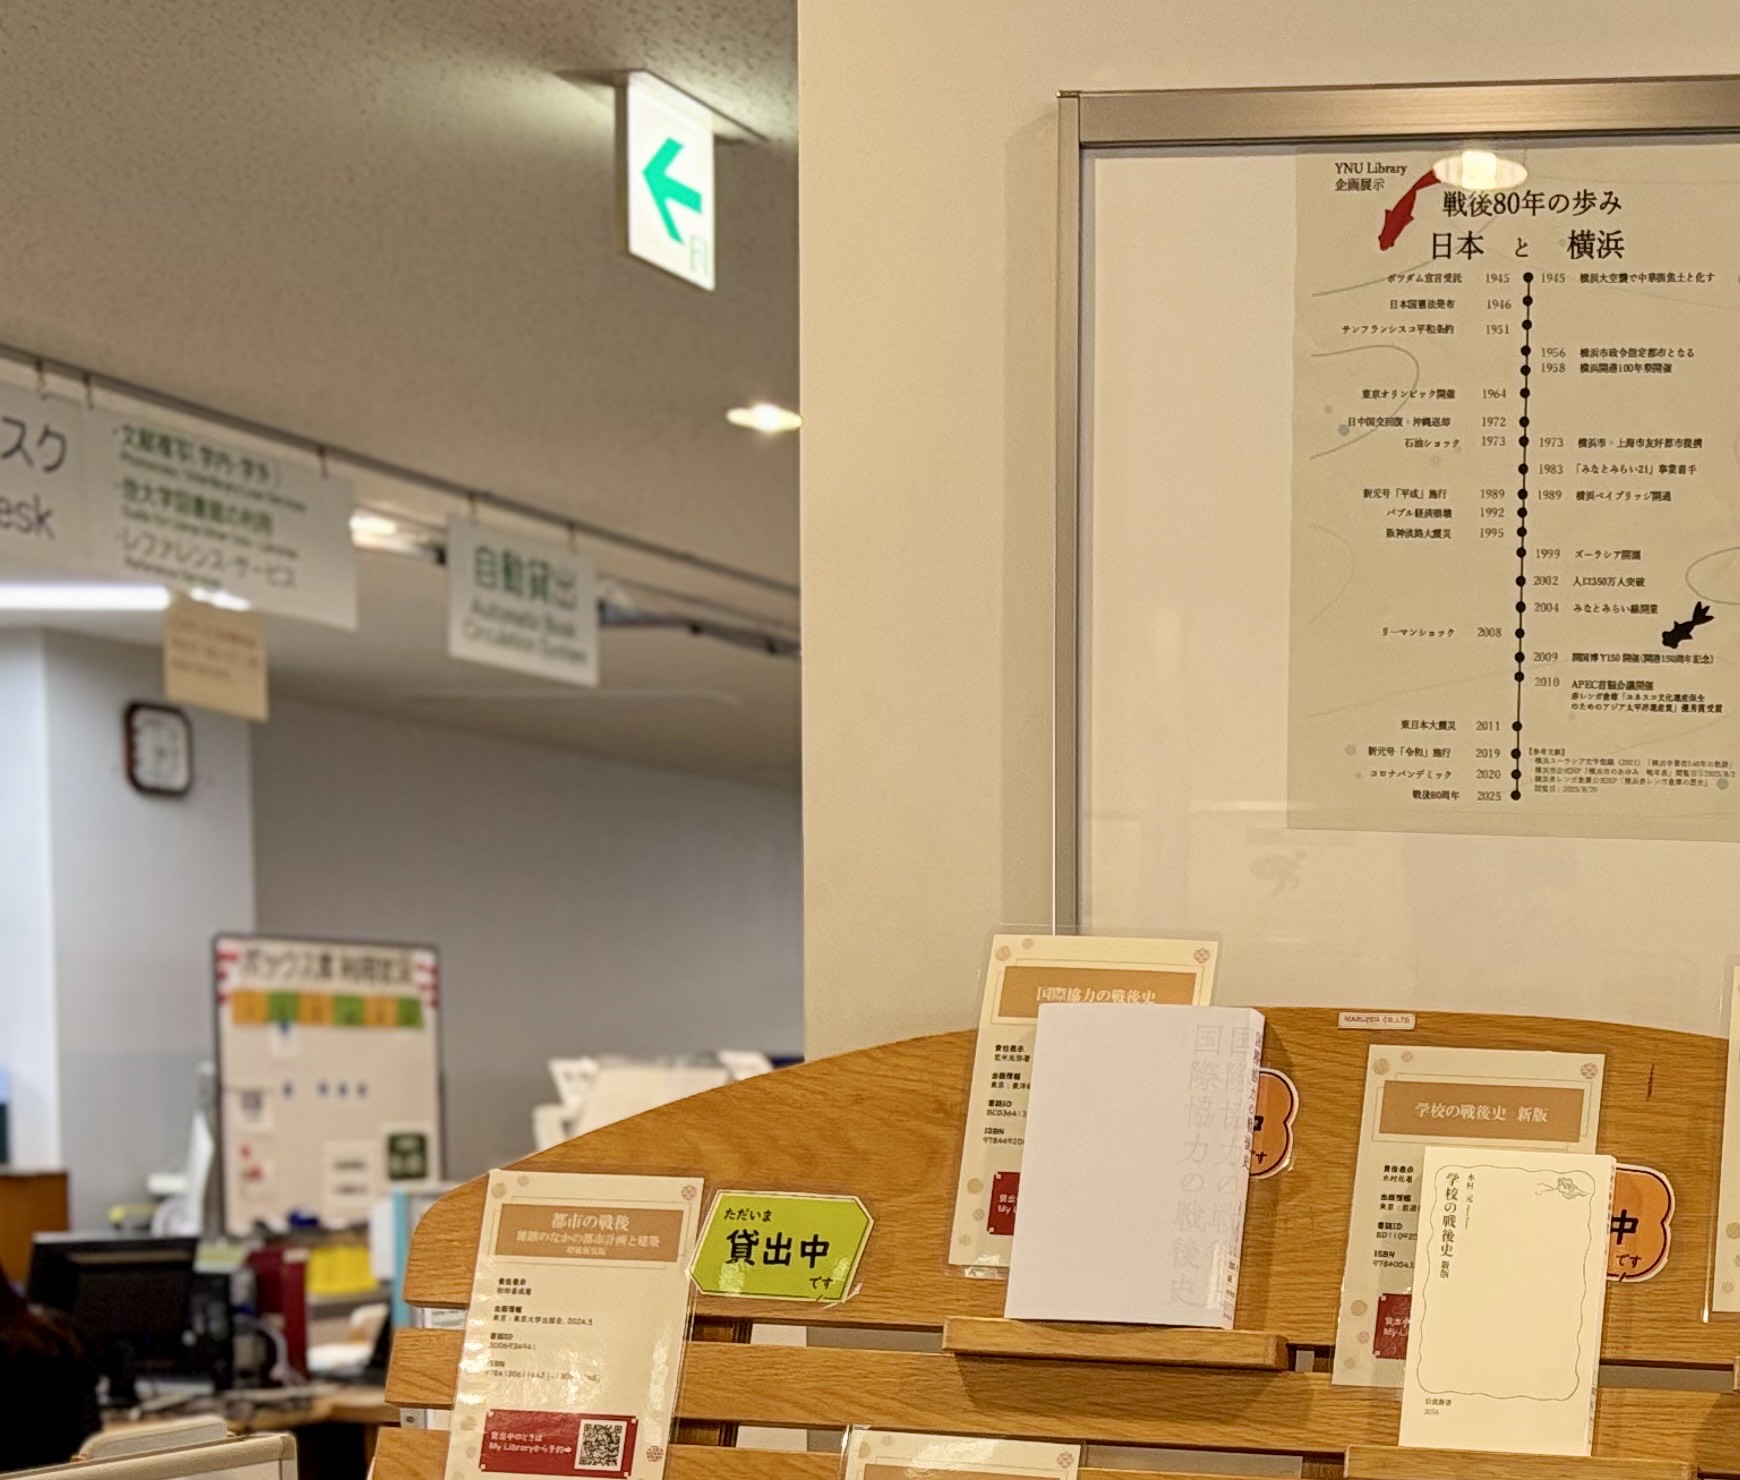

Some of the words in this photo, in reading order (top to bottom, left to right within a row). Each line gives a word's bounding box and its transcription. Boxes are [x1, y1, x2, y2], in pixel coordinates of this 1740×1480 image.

[1335, 162, 1363, 175] YNU
[1367, 162, 1407, 176] Library
[1334, 178, 1386, 192] 企画展示
[1442, 190, 1622, 218] 戦後80年の歩み
[1432, 231, 1485, 260] 日本
[1514, 237, 1530, 258] と
[1566, 229, 1625, 260] 横浜
[1486, 273, 1510, 283] 1945
[1541, 273, 1565, 283] 1945
[1487, 300, 1511, 310] 1946
[1486, 324, 1510, 334] 1951
[1541, 348, 1566, 358] 1956
[1541, 363, 1565, 373] 1958
[1482, 389, 1507, 400] 1964
[1481, 416, 1506, 427] 1972
[1405, 438, 1460, 448] 石油ショック
[1481, 436, 1506, 447] 1973
[1539, 438, 1564, 448] 1973
[1538, 464, 1564, 475] 1983
[1480, 489, 1505, 499] 1989
[1537, 490, 1562, 500] 1989
[1480, 507, 1505, 518] 1992
[1479, 528, 1504, 538] 1995
[1536, 549, 1560, 559] 1999
[1533, 576, 1559, 586] 2002
[1534, 602, 1560, 613] 2004
[1382, 627, 1455, 638] リーマンショック
[1477, 627, 1502, 637] 2008
[1534, 677, 1560, 687] 2010
[1476, 720, 1501, 731] 2011
[1476, 748, 1501, 758] 2019
[1476, 769, 1501, 780] 2020
[1415, 1101, 1507, 1123] 学校の戦後史
[1517, 1105, 1549, 1124] 新版
[723, 1206, 773, 1224] ただいま
[1439, 1172, 1460, 1258] 学校の戦後史
[551, 1212, 630, 1232] 都市の戦後
[725, 1227, 831, 1271] 貸出中
[1616, 1254, 1642, 1268] です
[807, 1275, 835, 1290] です
